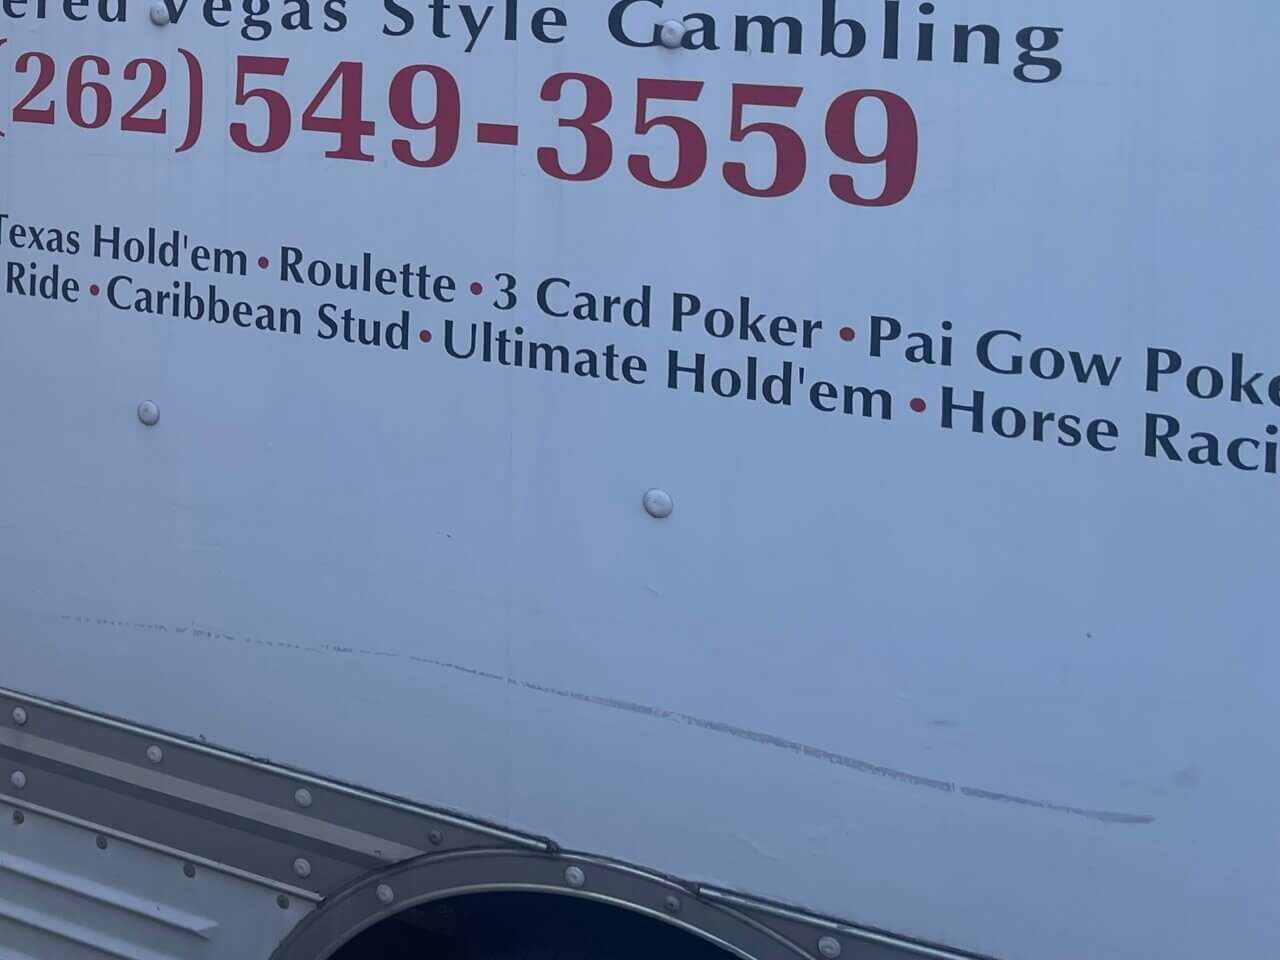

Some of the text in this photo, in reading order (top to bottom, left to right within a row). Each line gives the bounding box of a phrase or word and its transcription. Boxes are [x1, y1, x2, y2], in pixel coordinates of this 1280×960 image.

[229, 55, 918, 207] 549-3559
[6, 262, 80, 303] Ride
[107, 276, 302, 335] Caribbean
[317, 304, 409, 350] Stud
[444, 320, 648, 385] Ultimate
[666, 350, 893, 420] Hold'em
[941, 386, 1119, 452] Horse
[93, 224, 247, 276] Hold'em
[280, 246, 456, 302] Roulette
[493, 273, 518, 310] 3
[536, 277, 652, 328] Card
[671, 292, 822, 349] Poker
[869, 316, 953, 368] Pai
[976, 330, 1122, 387] Gow
